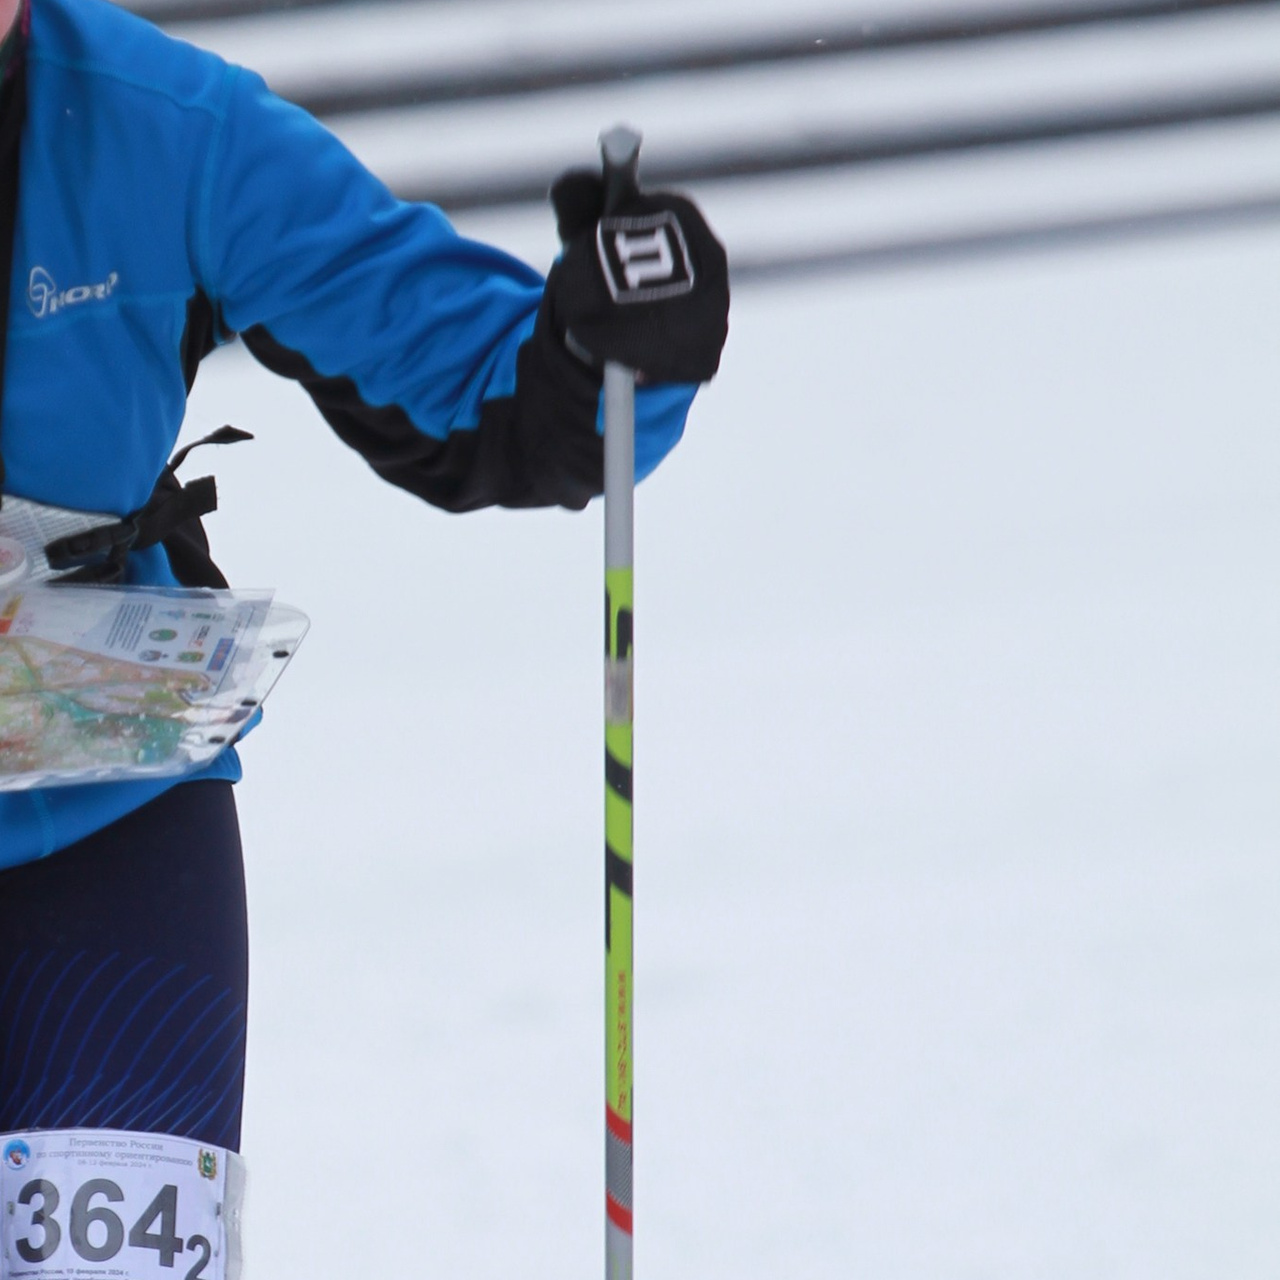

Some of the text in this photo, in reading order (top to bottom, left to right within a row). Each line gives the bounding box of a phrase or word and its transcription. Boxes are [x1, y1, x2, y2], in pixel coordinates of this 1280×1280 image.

[69, 1137, 164, 1152] Первенство России
[115, 1150, 194, 1167] ориентированию
[16, 1178, 183, 1268] 364
